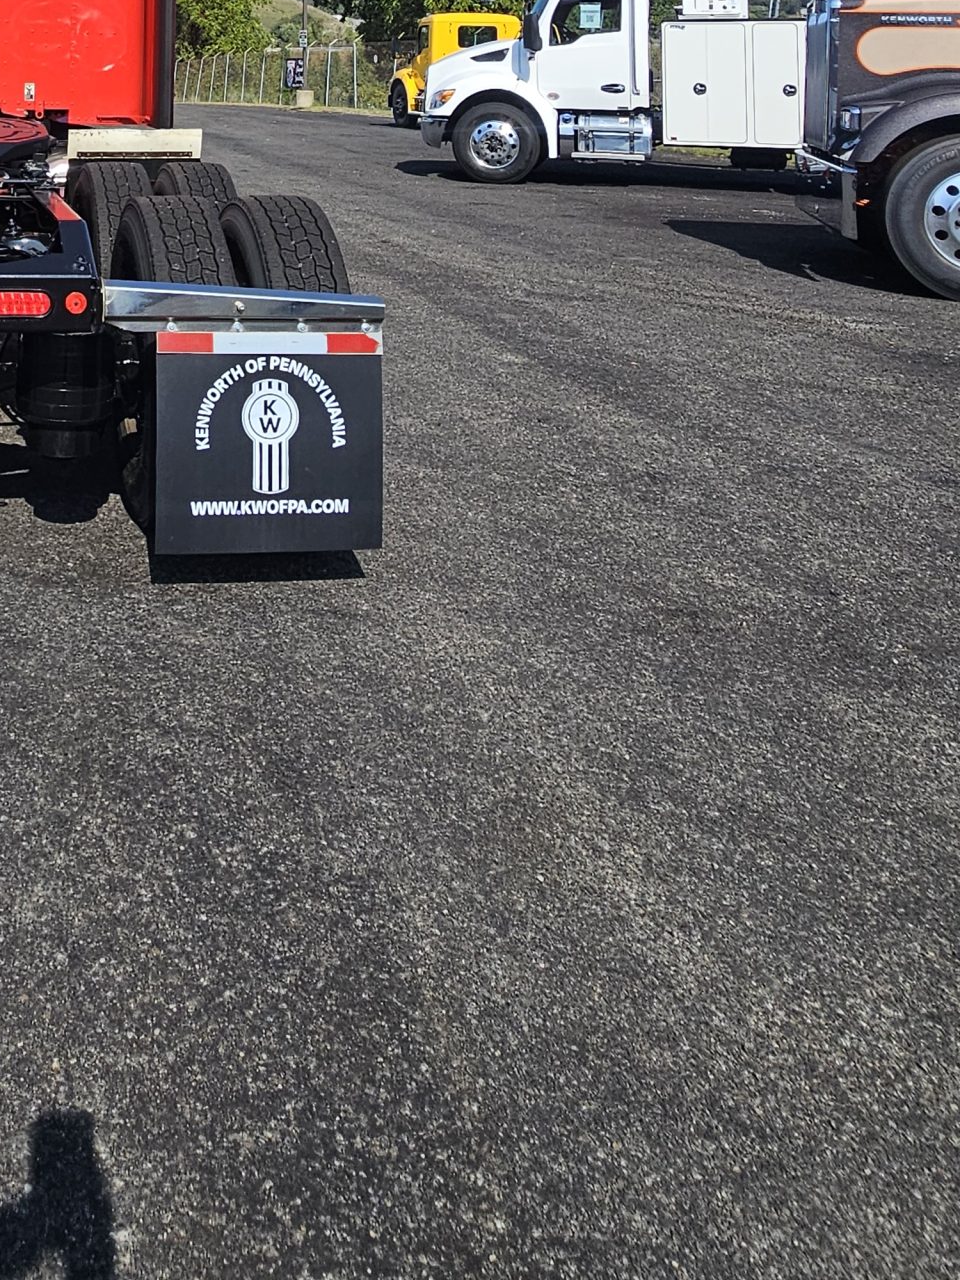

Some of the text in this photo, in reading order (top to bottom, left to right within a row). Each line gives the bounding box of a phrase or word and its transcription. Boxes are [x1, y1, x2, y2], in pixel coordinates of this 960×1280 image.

[880, 15, 953, 24] KENWORTH
[195, 356, 346, 451] KENWORTH OF PENNSYLVANIA
[190, 498, 349, 516] WWW.KWOFPA.COM
